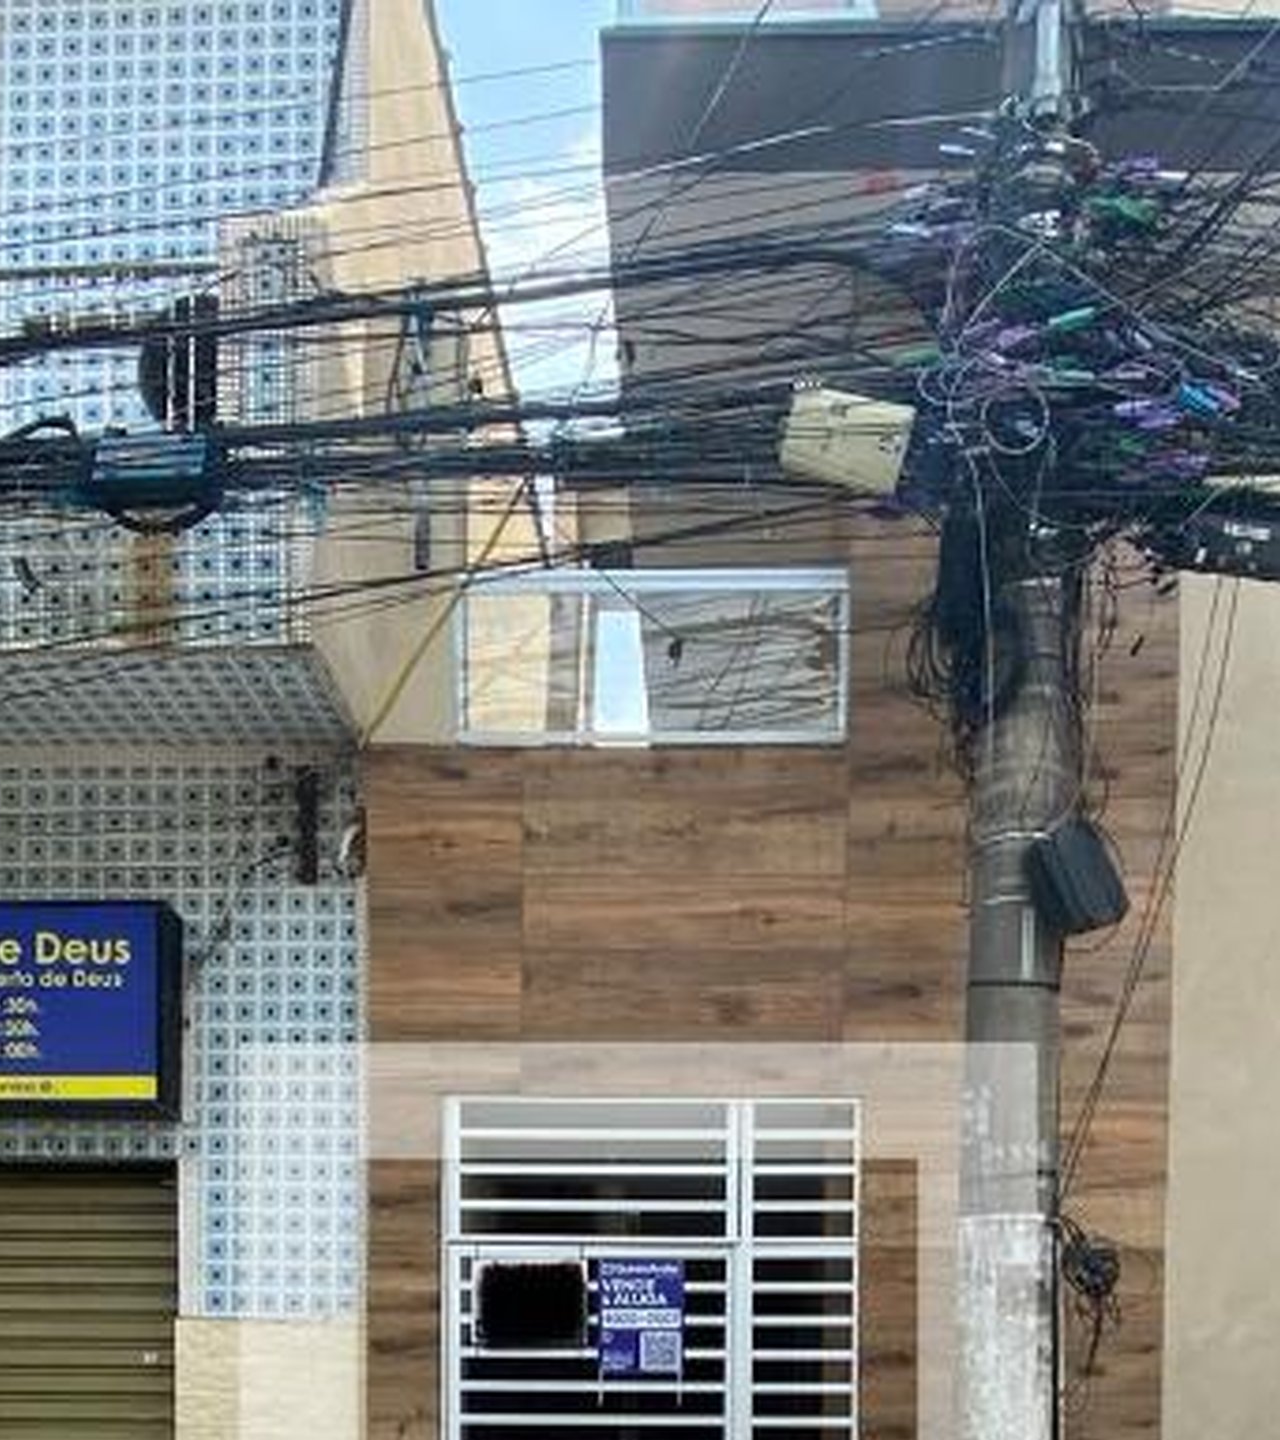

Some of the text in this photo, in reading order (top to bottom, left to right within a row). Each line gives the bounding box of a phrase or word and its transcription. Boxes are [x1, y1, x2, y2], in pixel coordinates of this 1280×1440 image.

[35, 931, 131, 965] Deus
[39, 969, 67, 988] de
[72, 969, 123, 988] Deus
